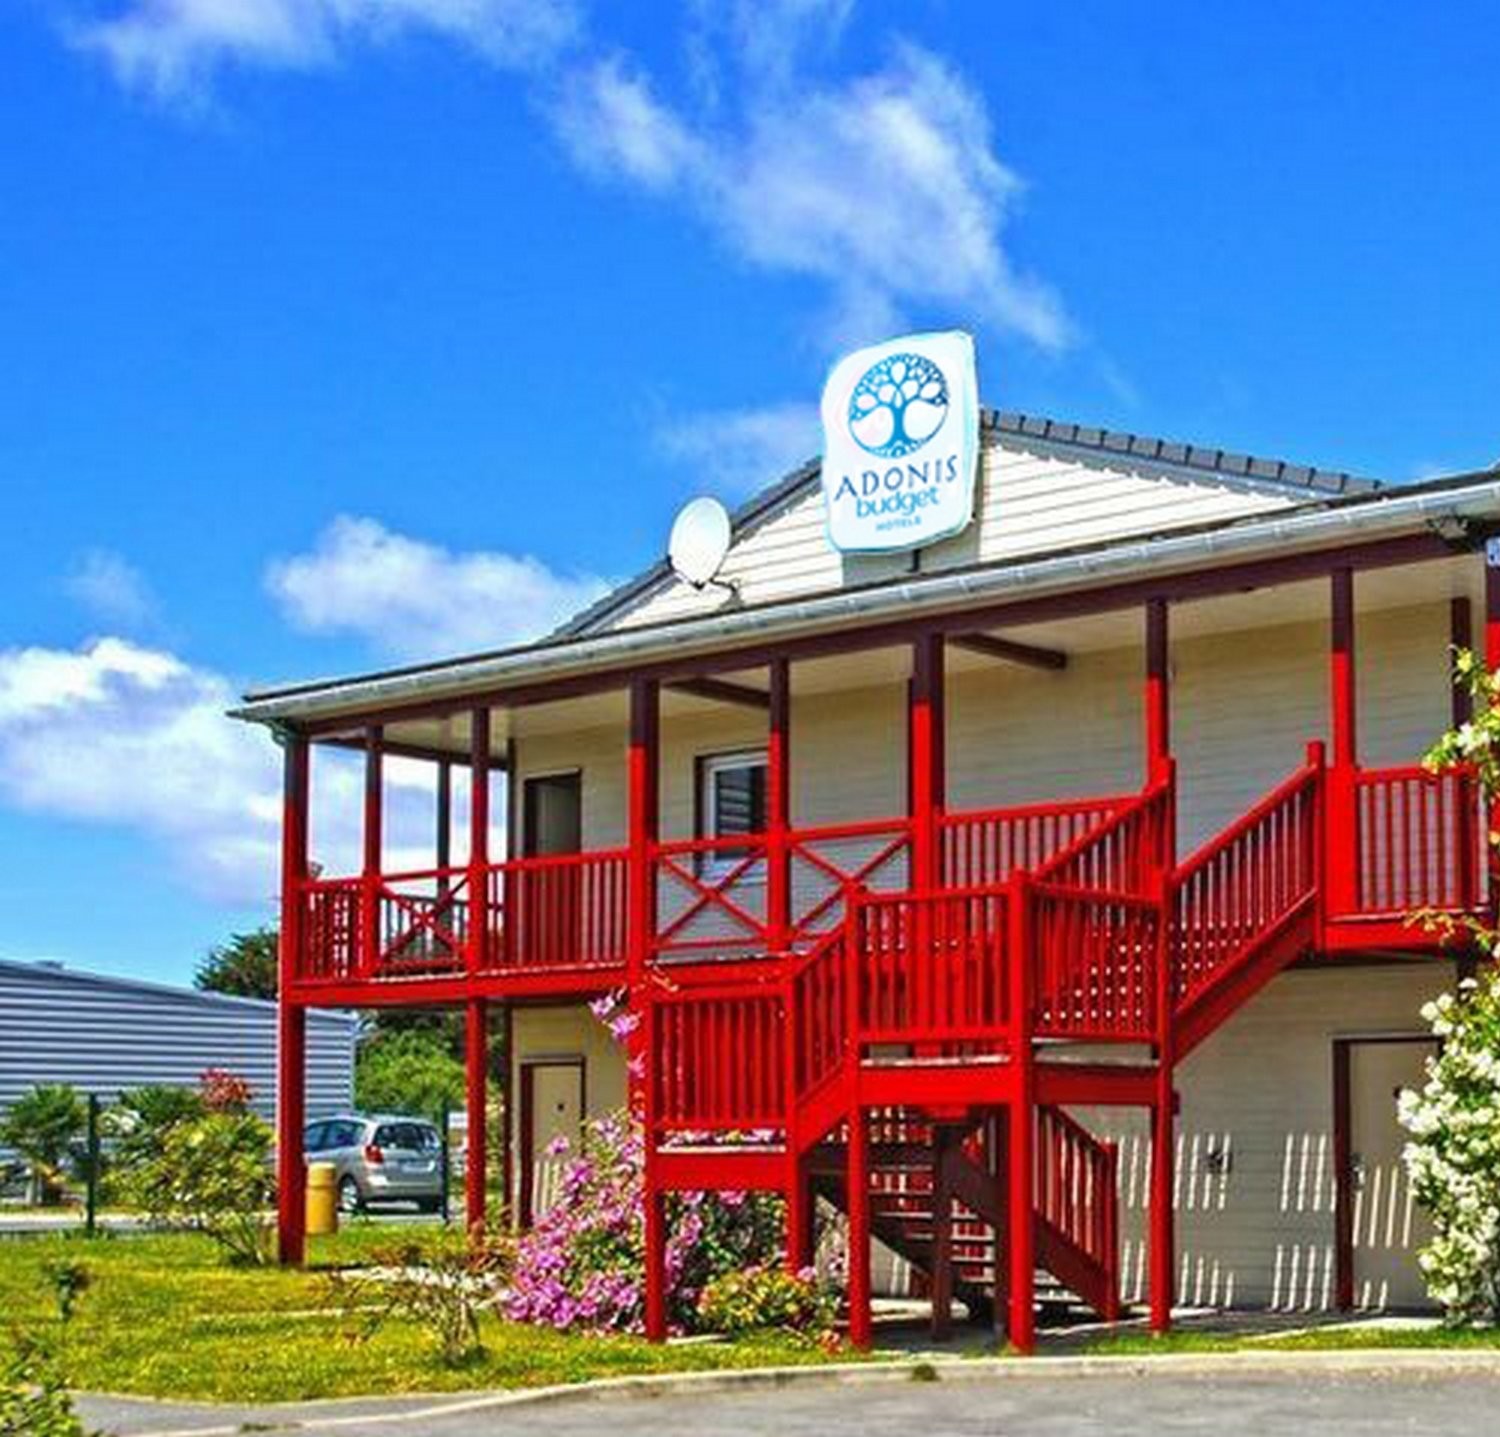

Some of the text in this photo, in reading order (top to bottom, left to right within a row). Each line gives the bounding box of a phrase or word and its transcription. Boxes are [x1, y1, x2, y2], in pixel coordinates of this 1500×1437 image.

[834, 454, 958, 501] ADONIS
[856, 486, 939, 518] budget
[875, 516, 921, 531] HOTELS
